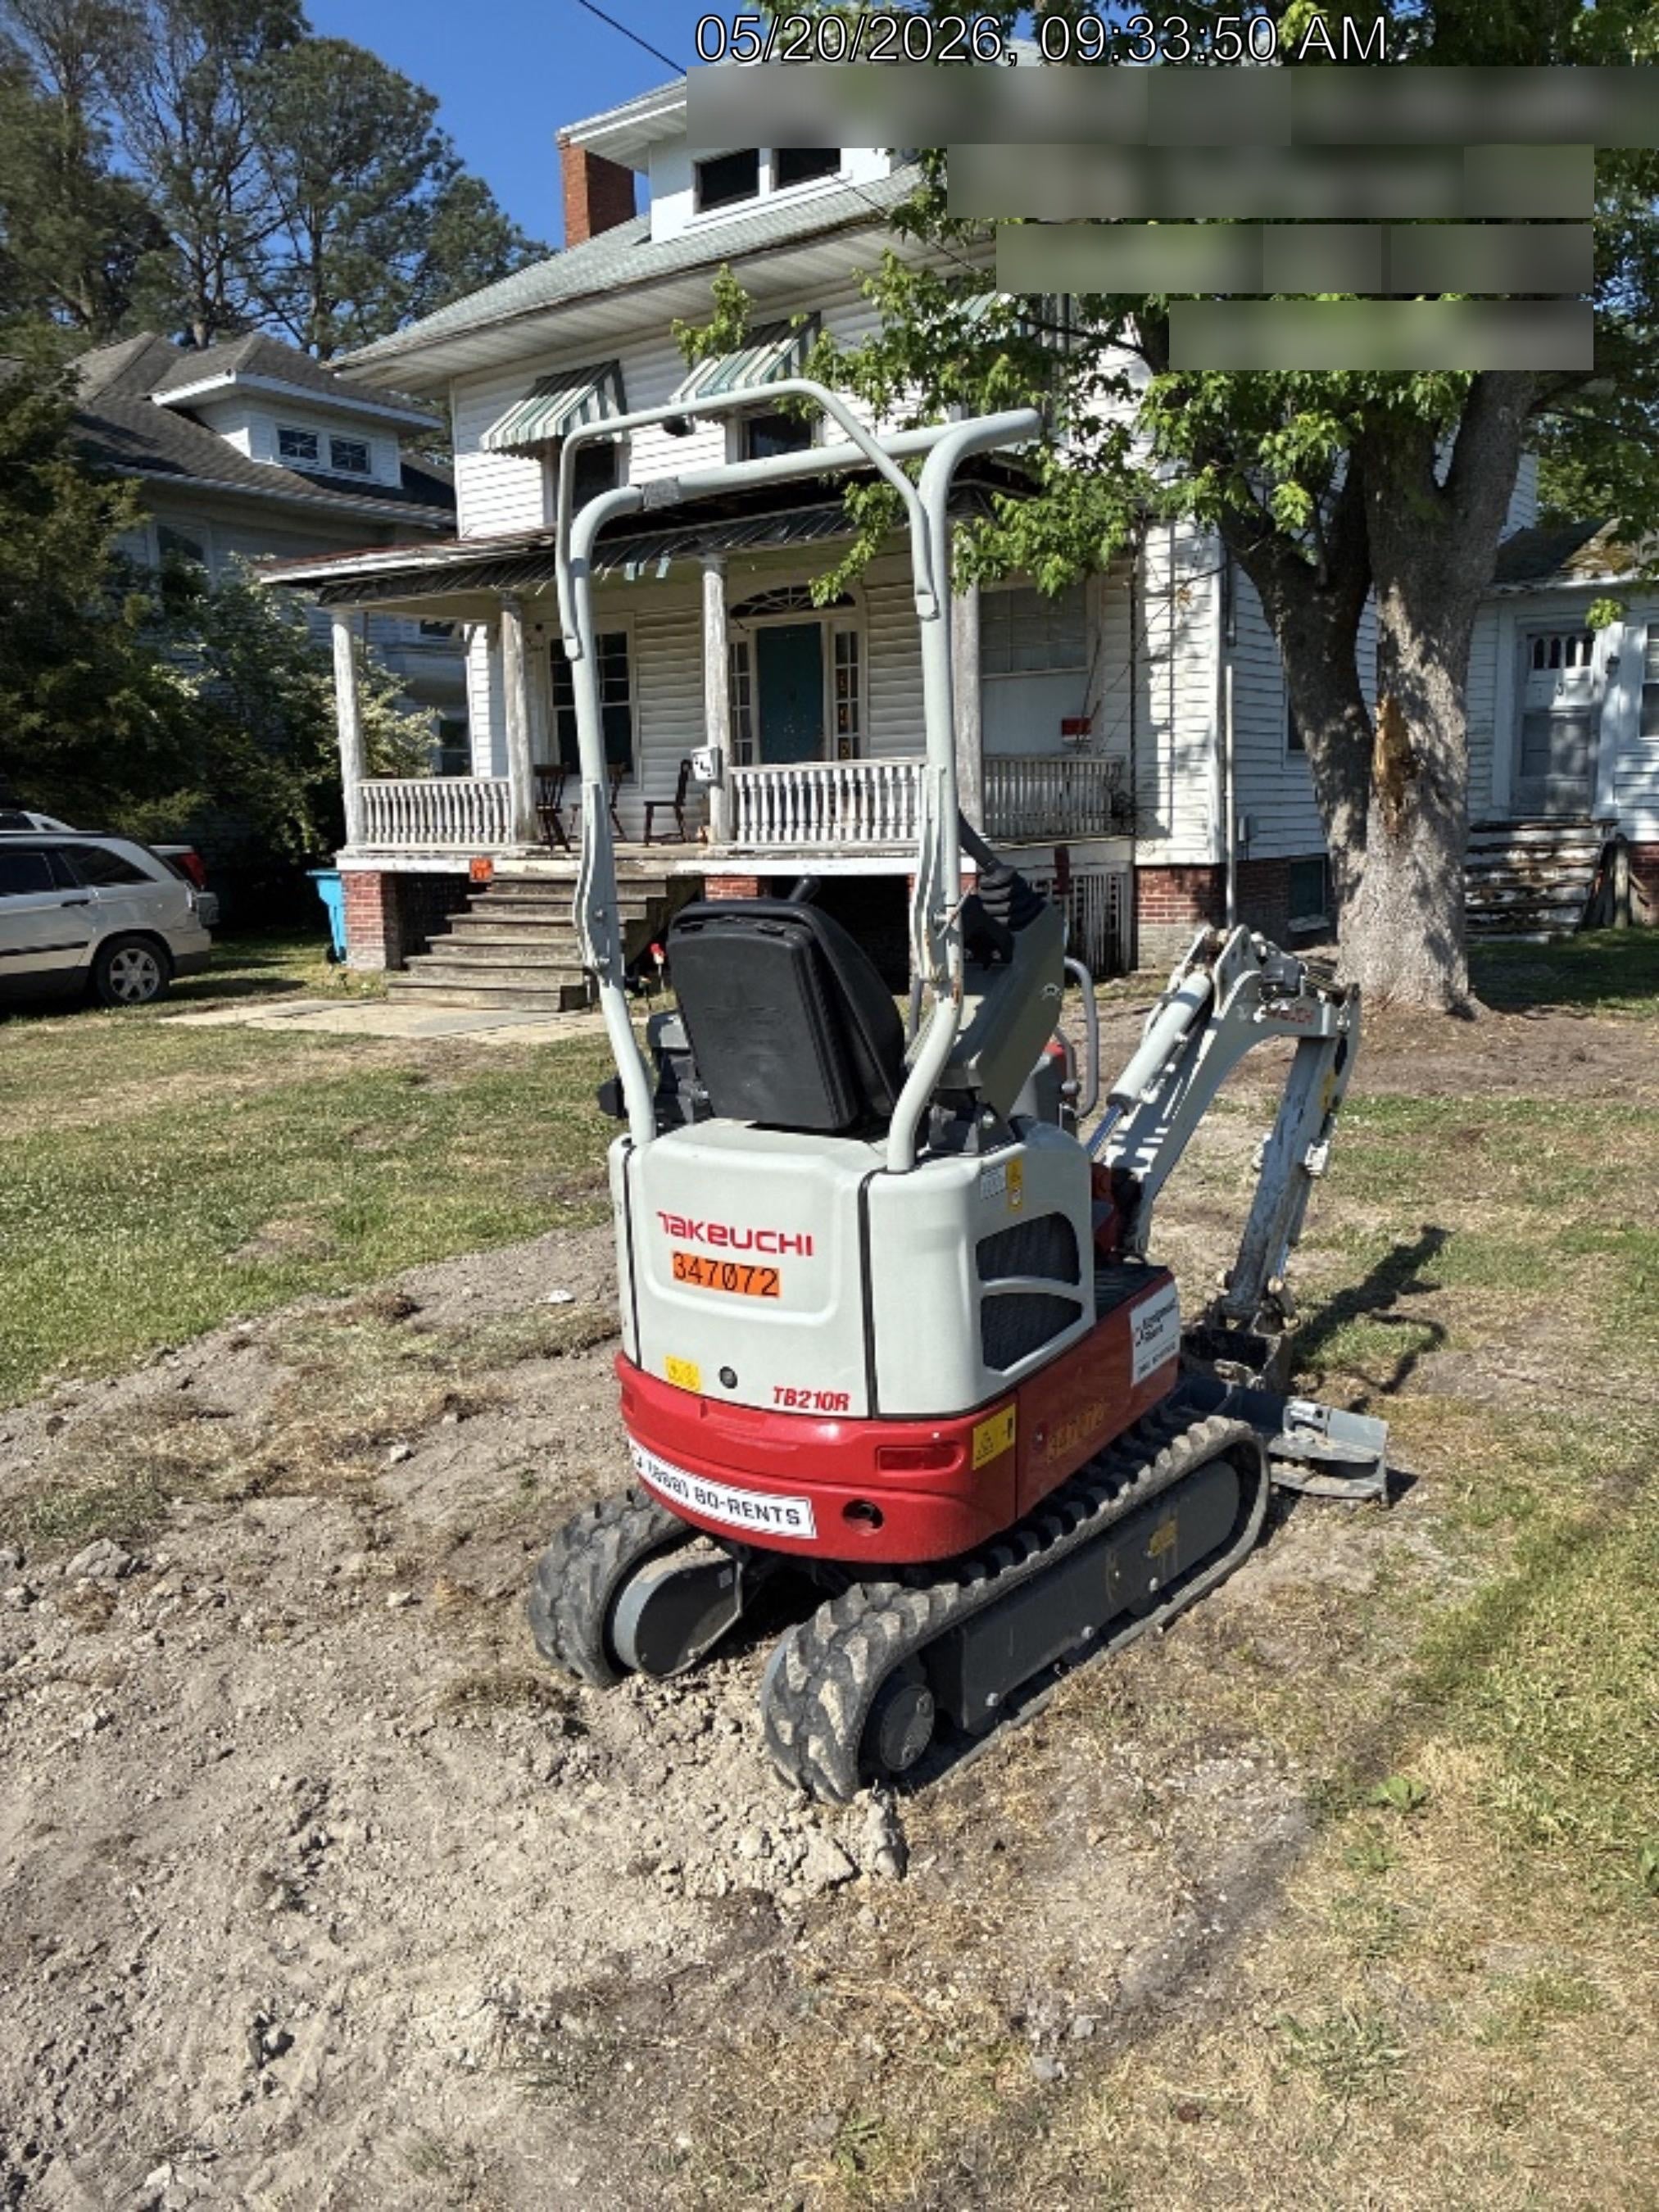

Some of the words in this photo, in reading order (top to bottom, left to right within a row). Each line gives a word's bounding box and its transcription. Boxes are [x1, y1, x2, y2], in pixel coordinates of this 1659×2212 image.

[672, 1251, 780, 1296] 347072
[773, 1385, 850, 1411] TB210R
[694, 1486, 802, 1525] 80-RENTS
